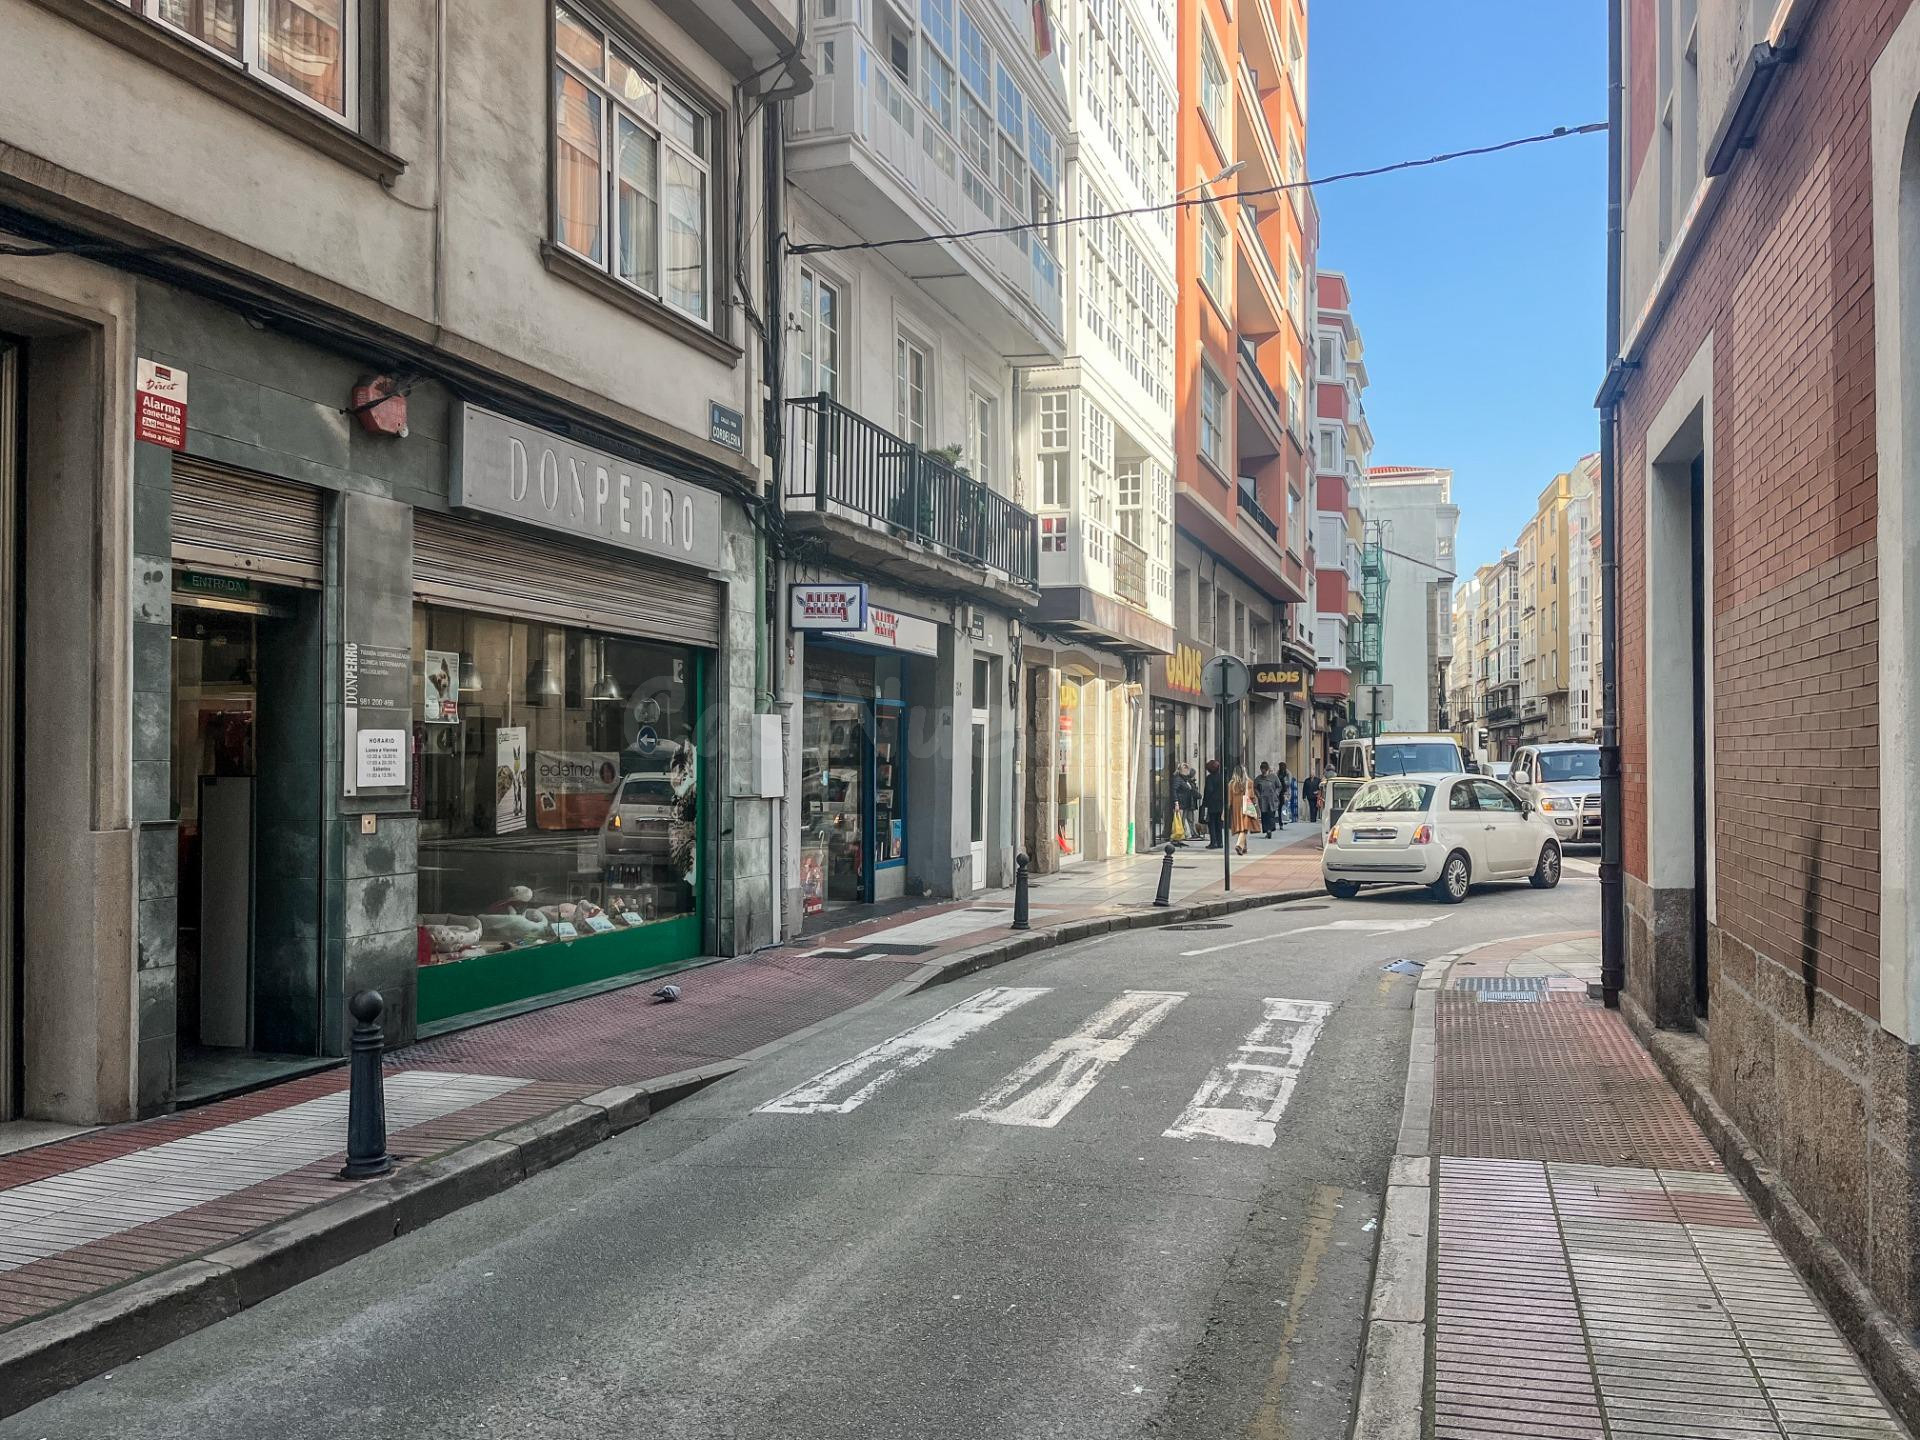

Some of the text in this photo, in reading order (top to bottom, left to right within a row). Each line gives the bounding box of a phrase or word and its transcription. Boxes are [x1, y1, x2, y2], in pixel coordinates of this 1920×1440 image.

[142, 396, 181, 416] Alarma
[142, 408, 181, 425] conectada
[508, 436, 695, 552] DONPERRO
[1165, 642, 1202, 695] GADIS
[1256, 671, 1301, 684] GADIS
